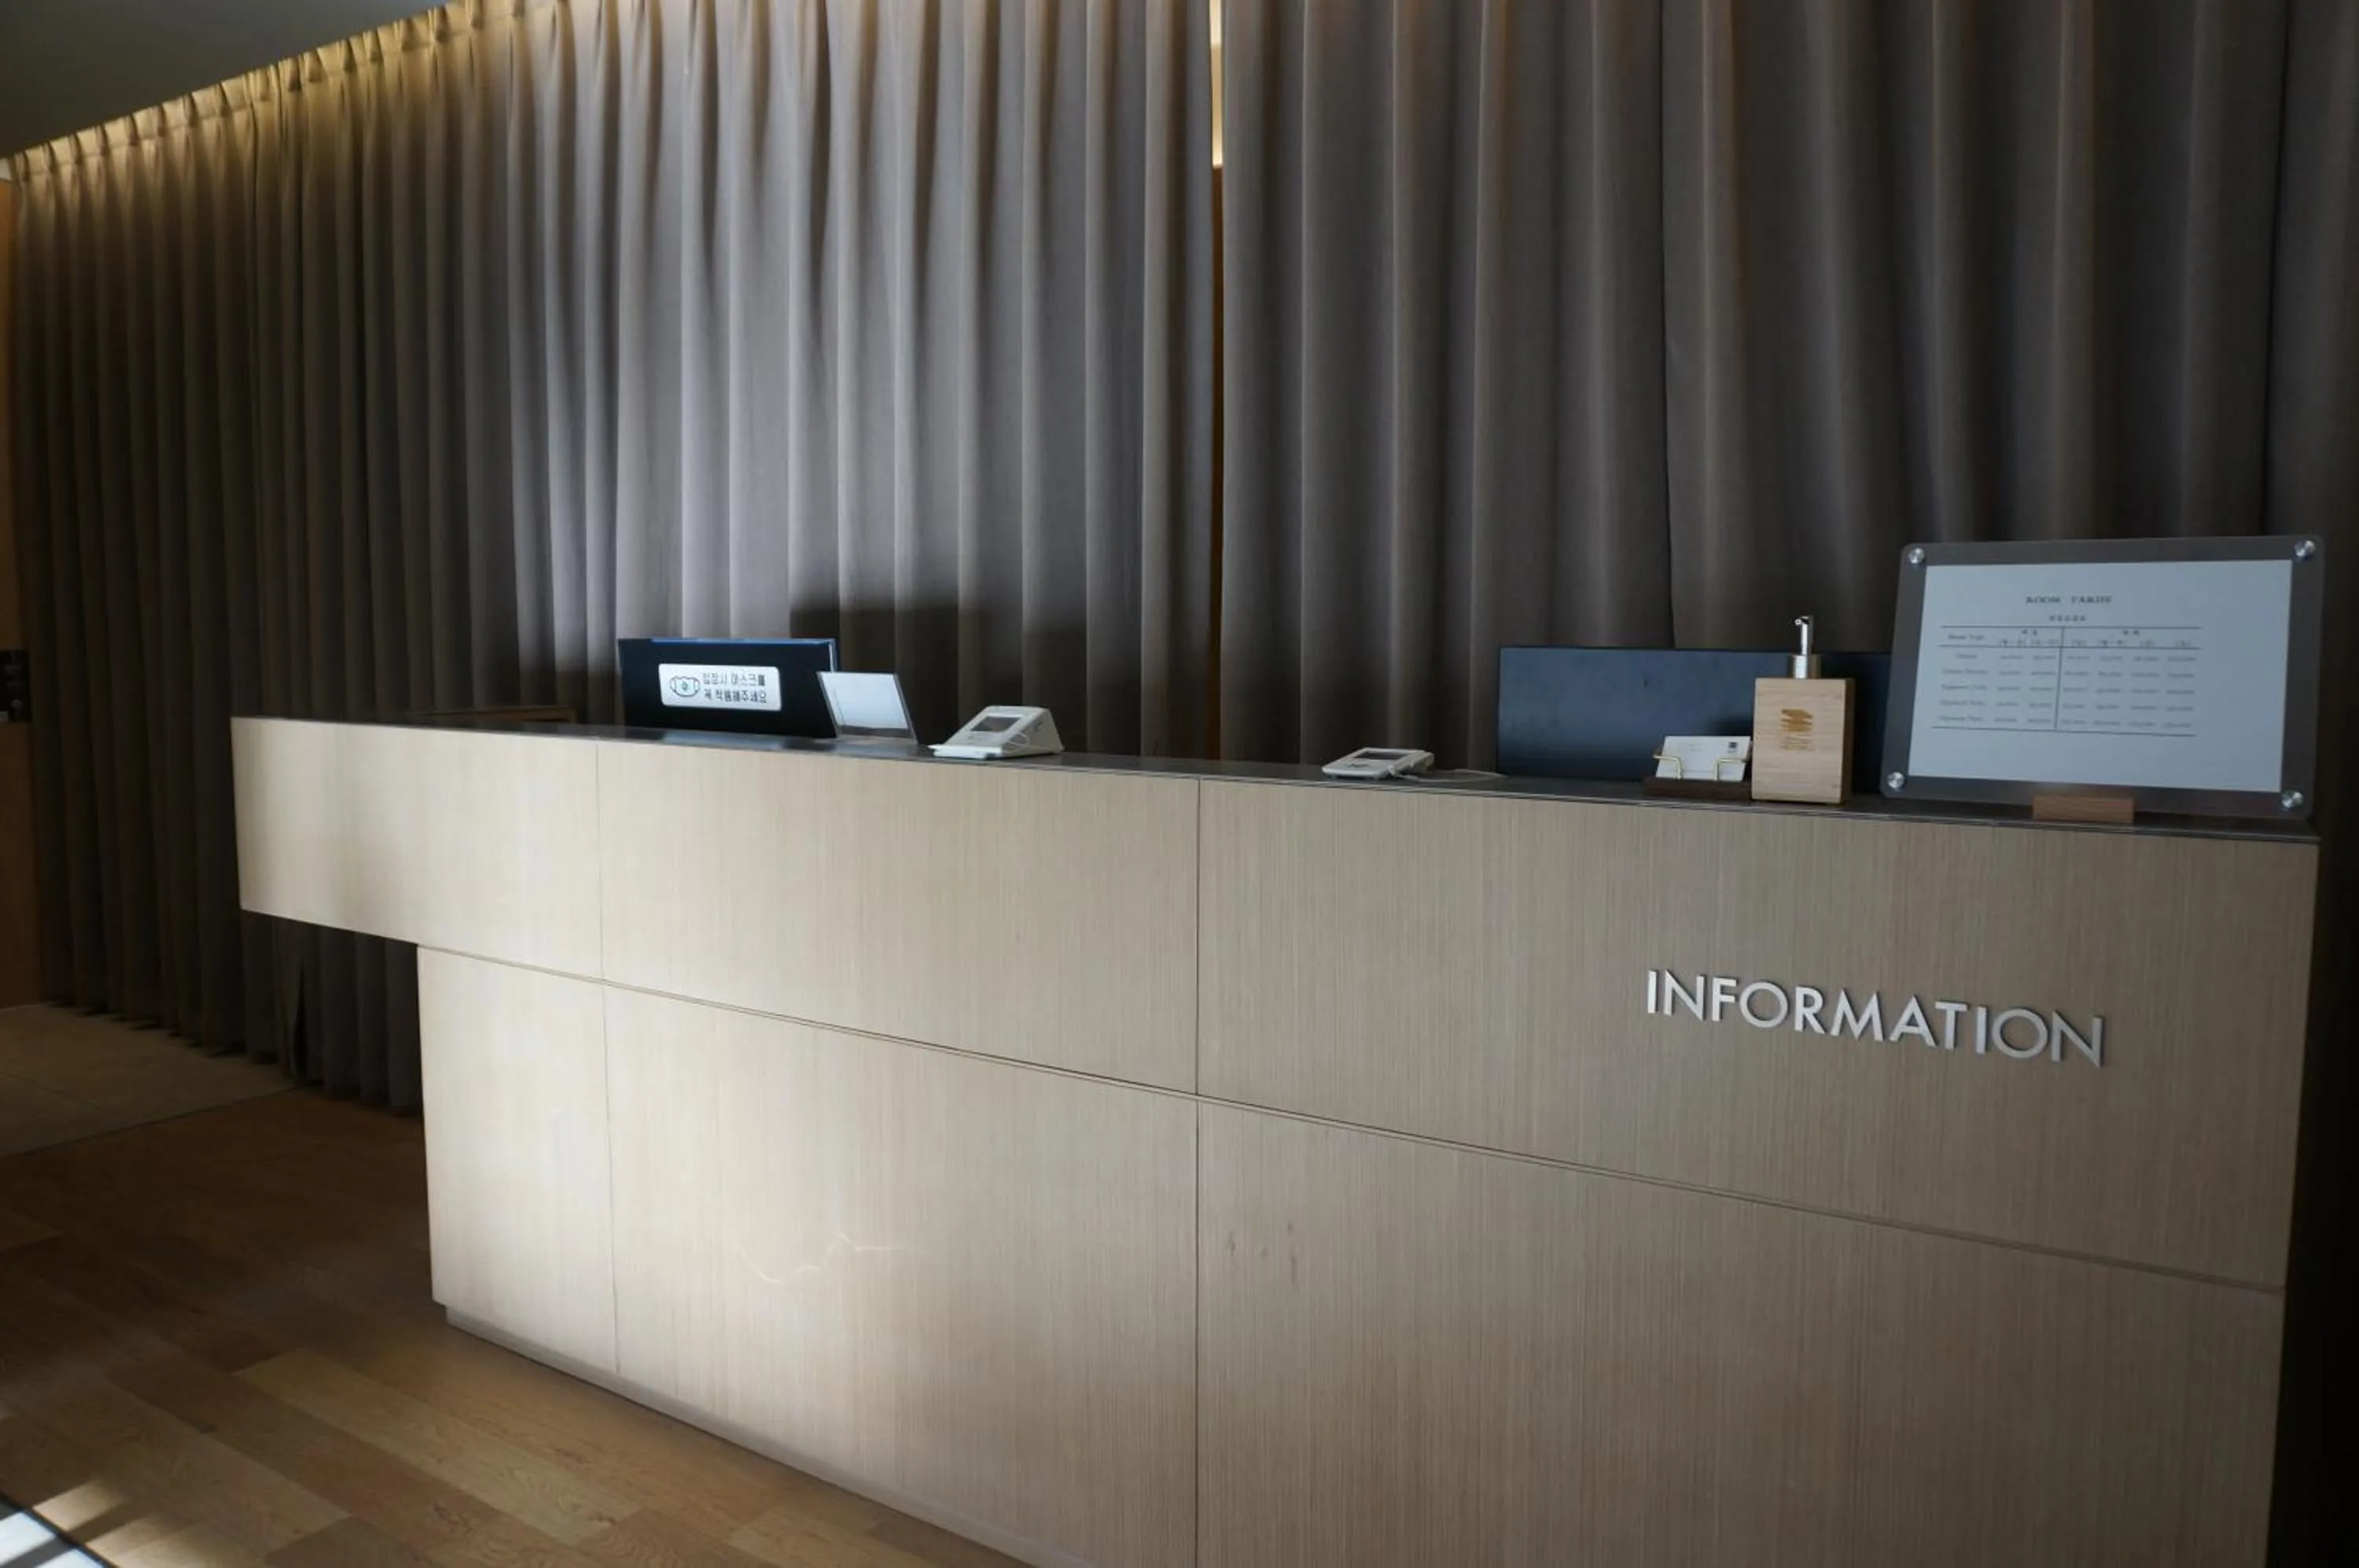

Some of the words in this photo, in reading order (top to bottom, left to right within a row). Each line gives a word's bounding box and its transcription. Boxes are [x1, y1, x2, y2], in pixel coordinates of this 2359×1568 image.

[731, 672, 765, 686] 마스크를
[716, 689, 767, 703] 착용해주세요
[1647, 969, 2103, 1068] INFORMATION
